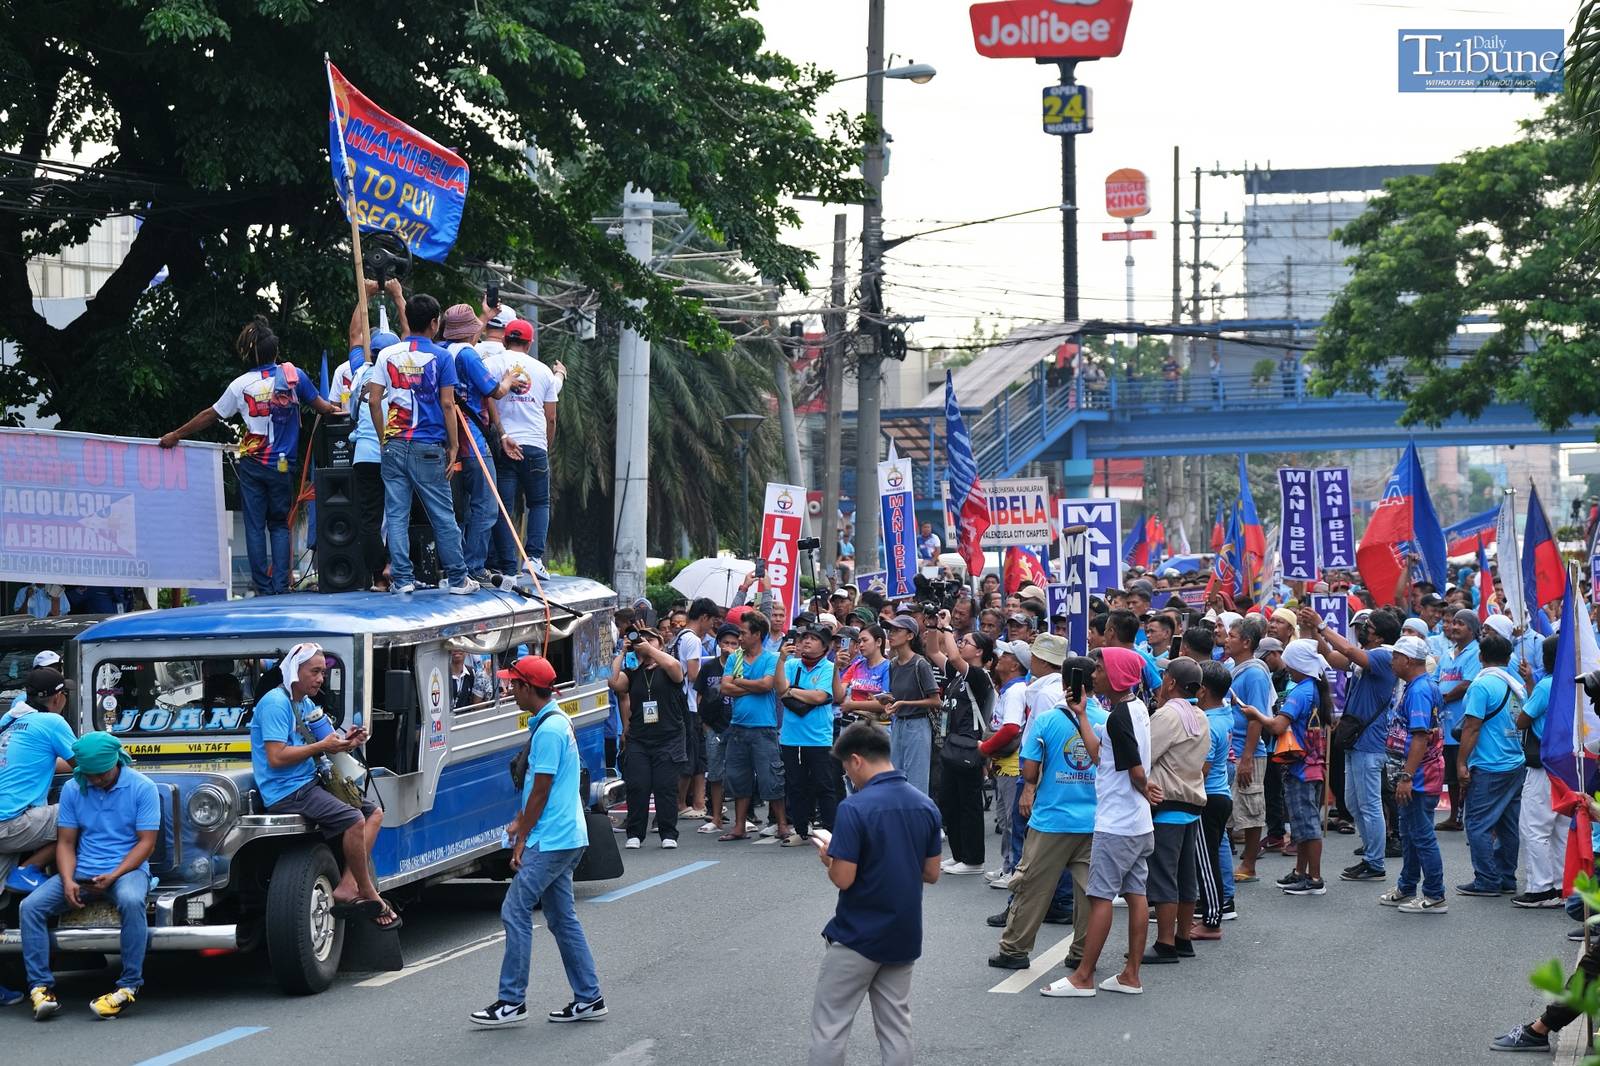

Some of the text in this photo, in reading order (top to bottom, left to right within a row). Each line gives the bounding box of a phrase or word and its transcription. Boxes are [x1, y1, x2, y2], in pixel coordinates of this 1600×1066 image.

[979, 10, 1110, 46] Jollibee
[1043, 95, 1085, 123] 24
[1046, 123, 1083, 132] HOURS
[347, 118, 465, 194] MANIBELA
[362, 165, 396, 201] TO
[1106, 181, 1146, 193] BURGER
[1106, 193, 1146, 208] KING
[1286, 471, 1309, 577] MANIBELA
[1323, 470, 1347, 566] MANIBELA
[889, 495, 908, 594] MANIBELA
[1014, 530, 1025, 538] CITY
[1026, 529, 1049, 538] CHAPTER
[112, 708, 257, 733] JOAN
[124, 743, 231, 754] CLARAN VIA TAFT
